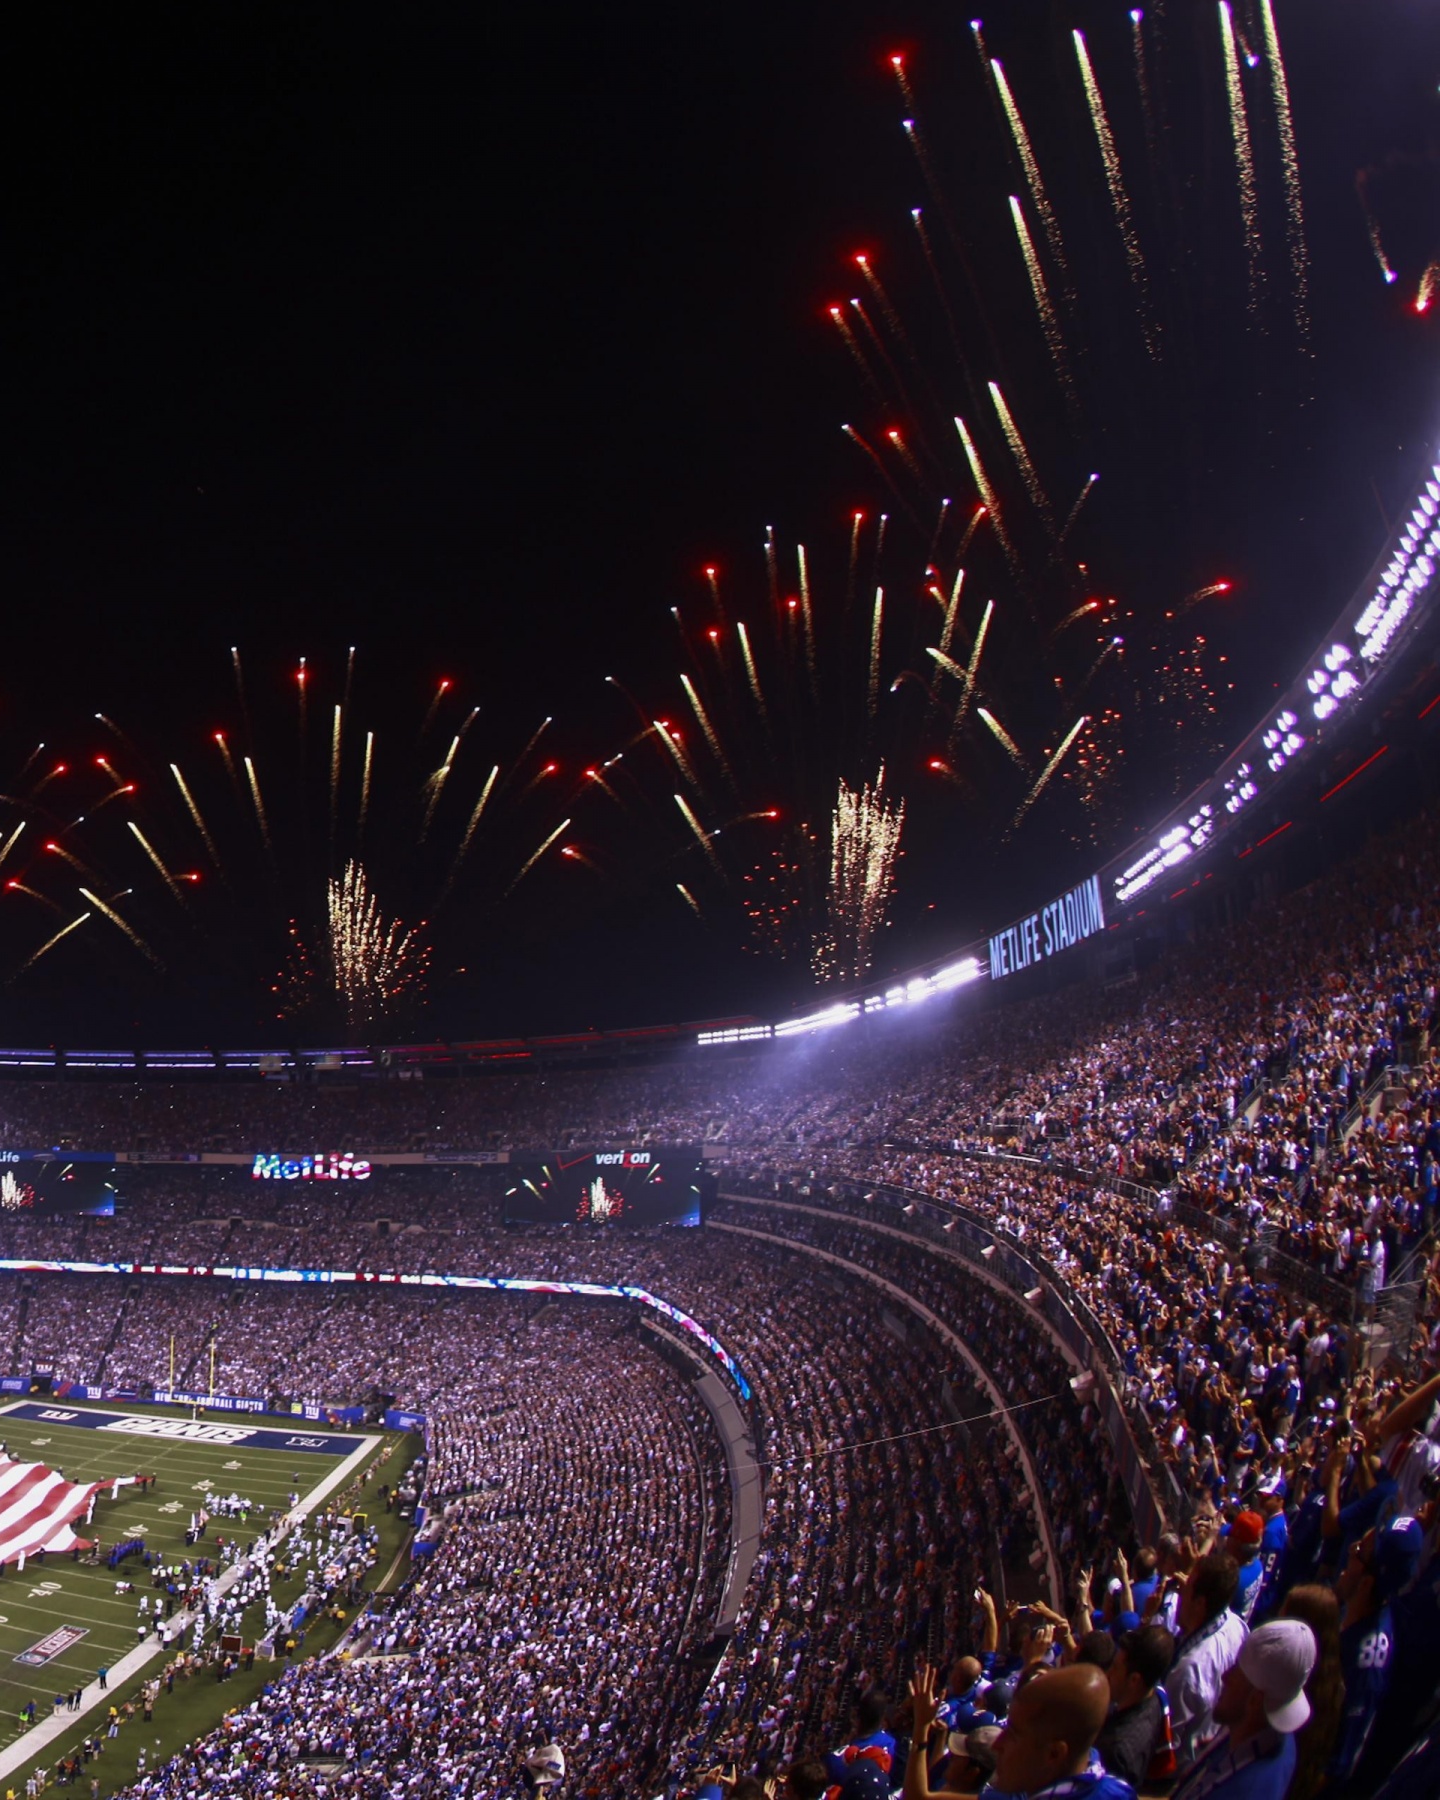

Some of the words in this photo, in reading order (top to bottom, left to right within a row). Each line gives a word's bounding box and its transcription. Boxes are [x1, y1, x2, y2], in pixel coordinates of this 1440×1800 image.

[989, 913, 1042, 980] METLIFE
[1042, 873, 1105, 957] STADIUM
[252, 1152, 372, 1180] MetLife
[595, 1150, 651, 1168] verizon
[96, 1417, 259, 1444] GIANTS
[31, 1582, 62, 1598] 40
[1359, 1632, 1389, 1668] 88
